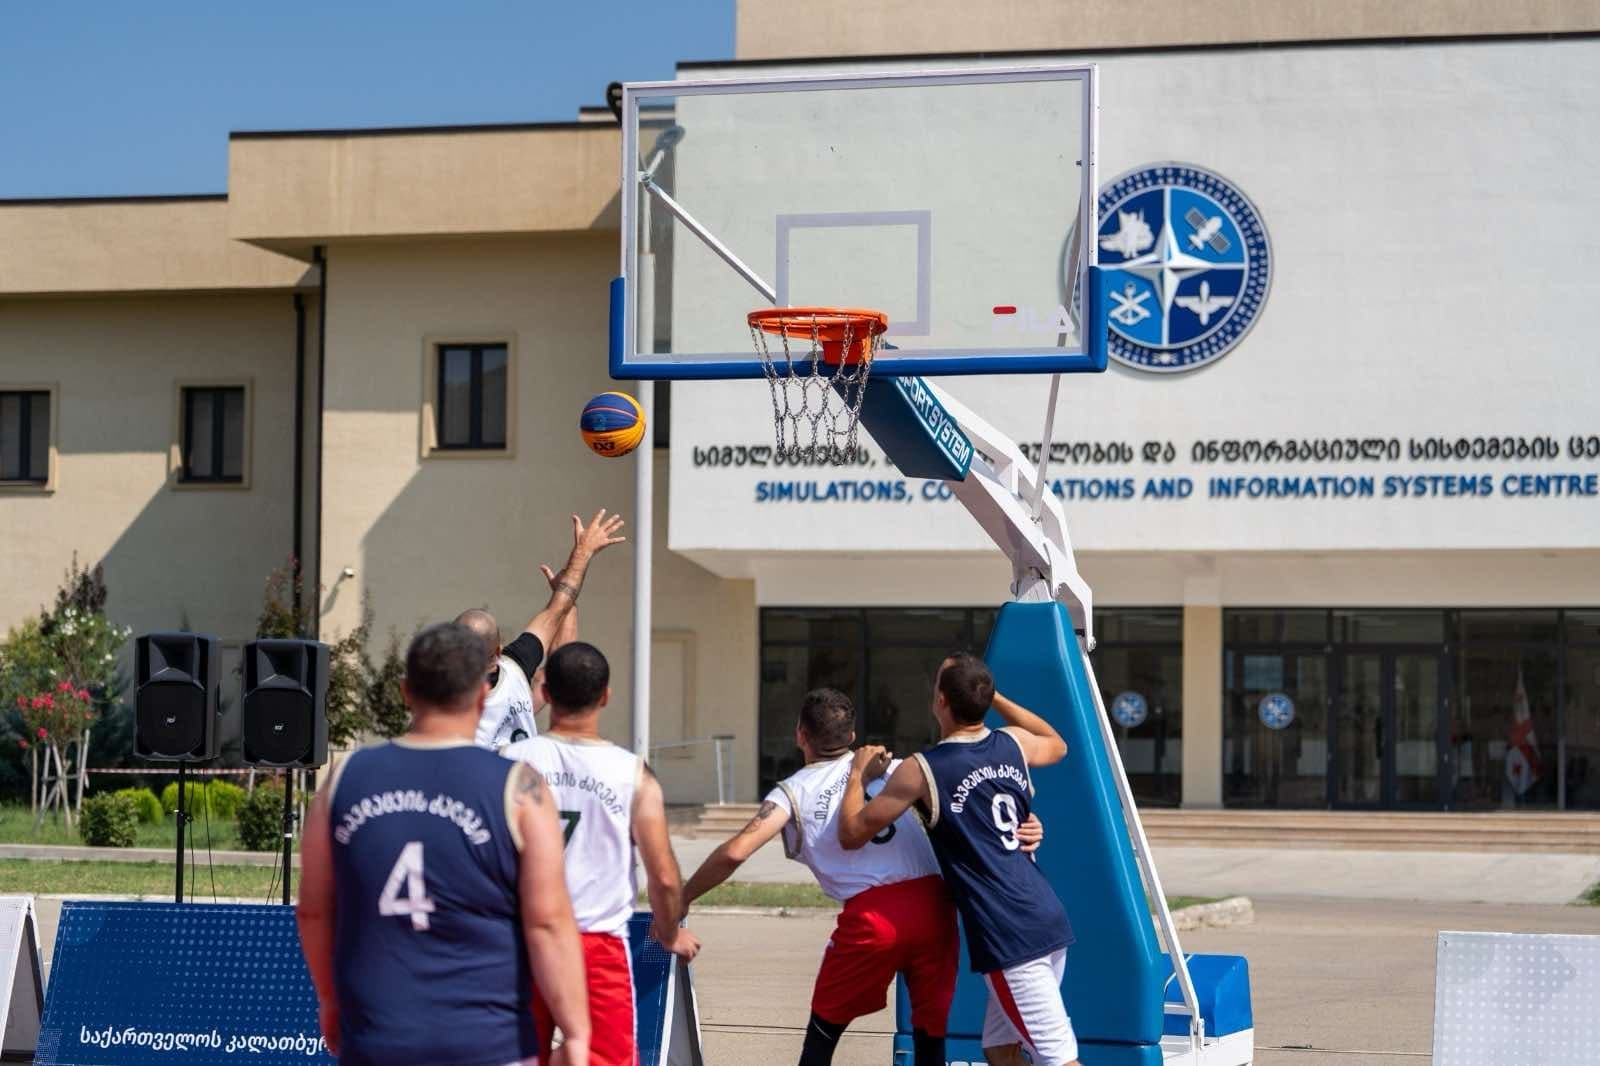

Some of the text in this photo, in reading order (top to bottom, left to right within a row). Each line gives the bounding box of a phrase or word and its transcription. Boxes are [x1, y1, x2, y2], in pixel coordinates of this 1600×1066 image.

[1142, 441, 1178, 464] და
[1192, 438, 1401, 463] ინფორმაციული
[1409, 436, 1560, 461] სისტემების
[755, 480, 915, 503] SIMULATIONS,
[1142, 477, 1194, 500] AND
[1208, 476, 1375, 499] INFORMATION
[1383, 475, 1494, 497] SYSTEMS
[1502, 474, 1599, 496] CENTRE
[558, 810, 582, 851] 7
[991, 793, 1020, 851] 9
[378, 841, 437, 931] 4
[80, 1025, 222, 1051] საქართველოს
